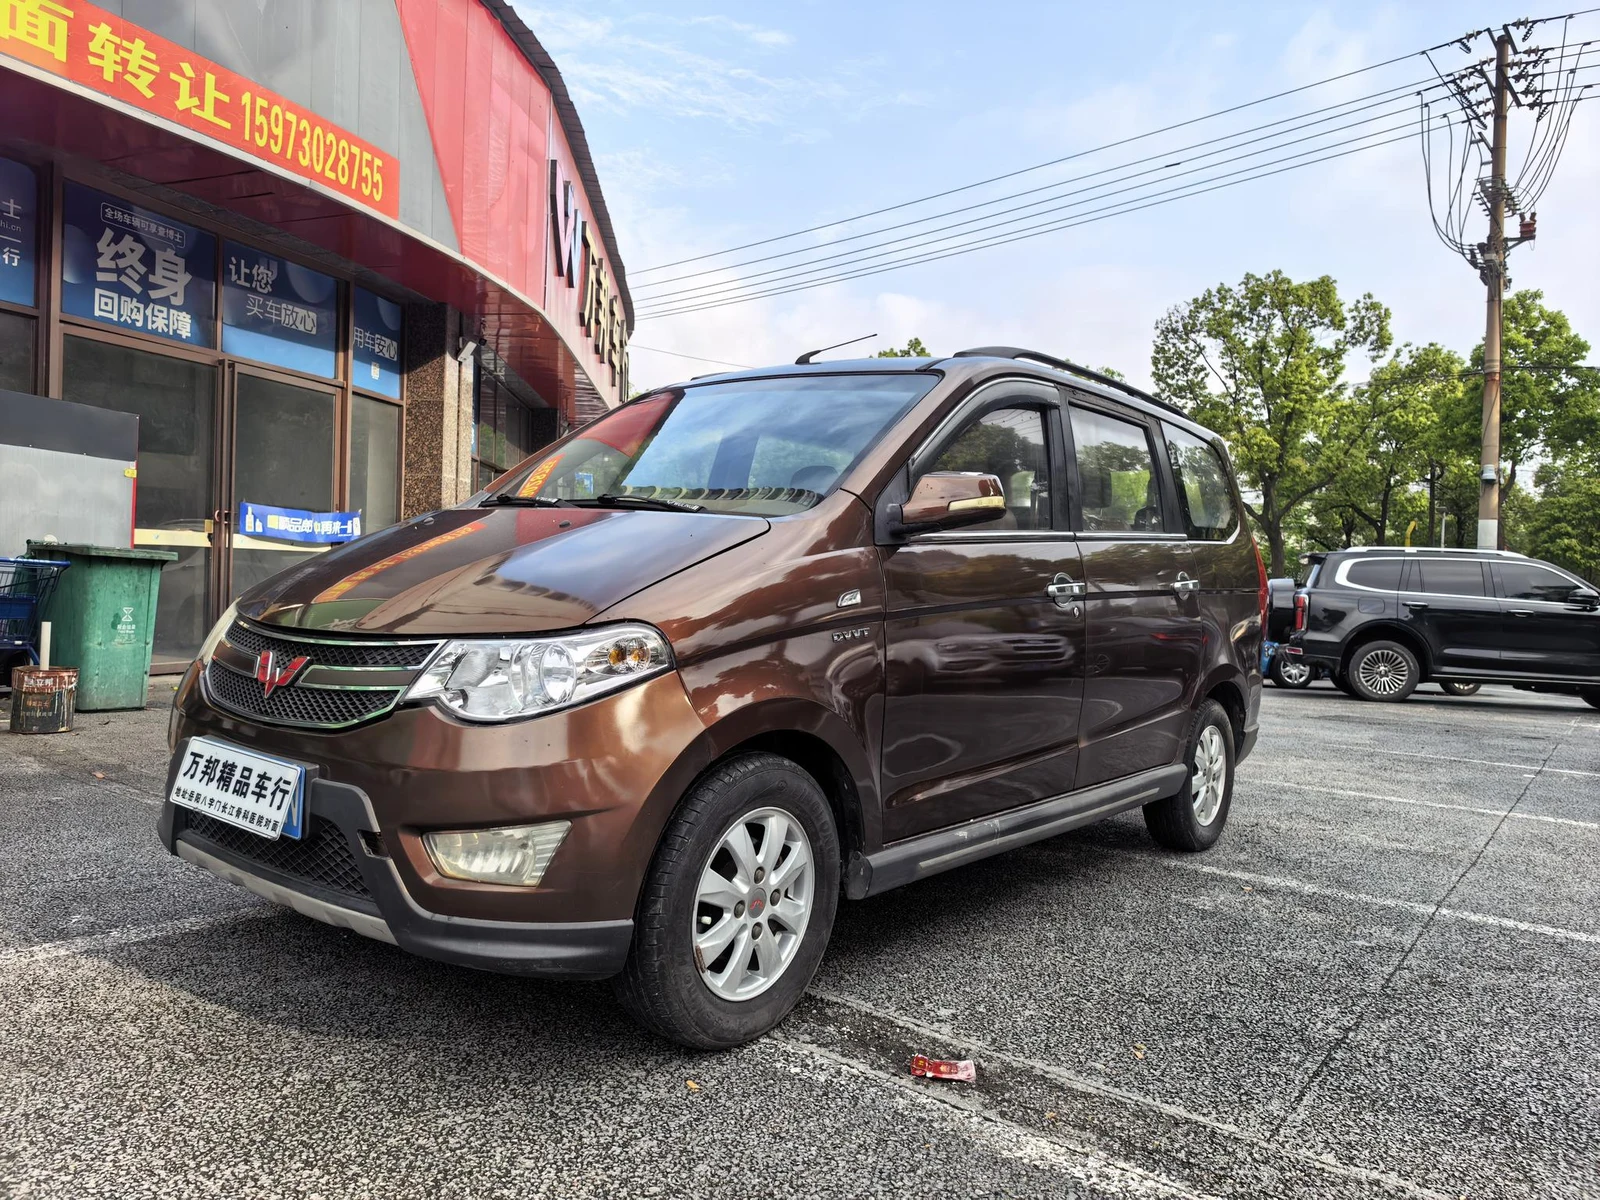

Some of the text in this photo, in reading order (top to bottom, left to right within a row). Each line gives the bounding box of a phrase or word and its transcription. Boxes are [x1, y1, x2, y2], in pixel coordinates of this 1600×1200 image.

[242, 92, 383, 202] 15973028755
[2, 247, 21, 267] 行
[96, 227, 193, 306] 终身
[229, 257, 273, 294] 让您
[94, 287, 192, 339] 回购保障
[246, 293, 317, 334] 买车放心
[353, 326, 397, 361] 用车安心
[183, 751, 292, 811] 万邦精品车行
